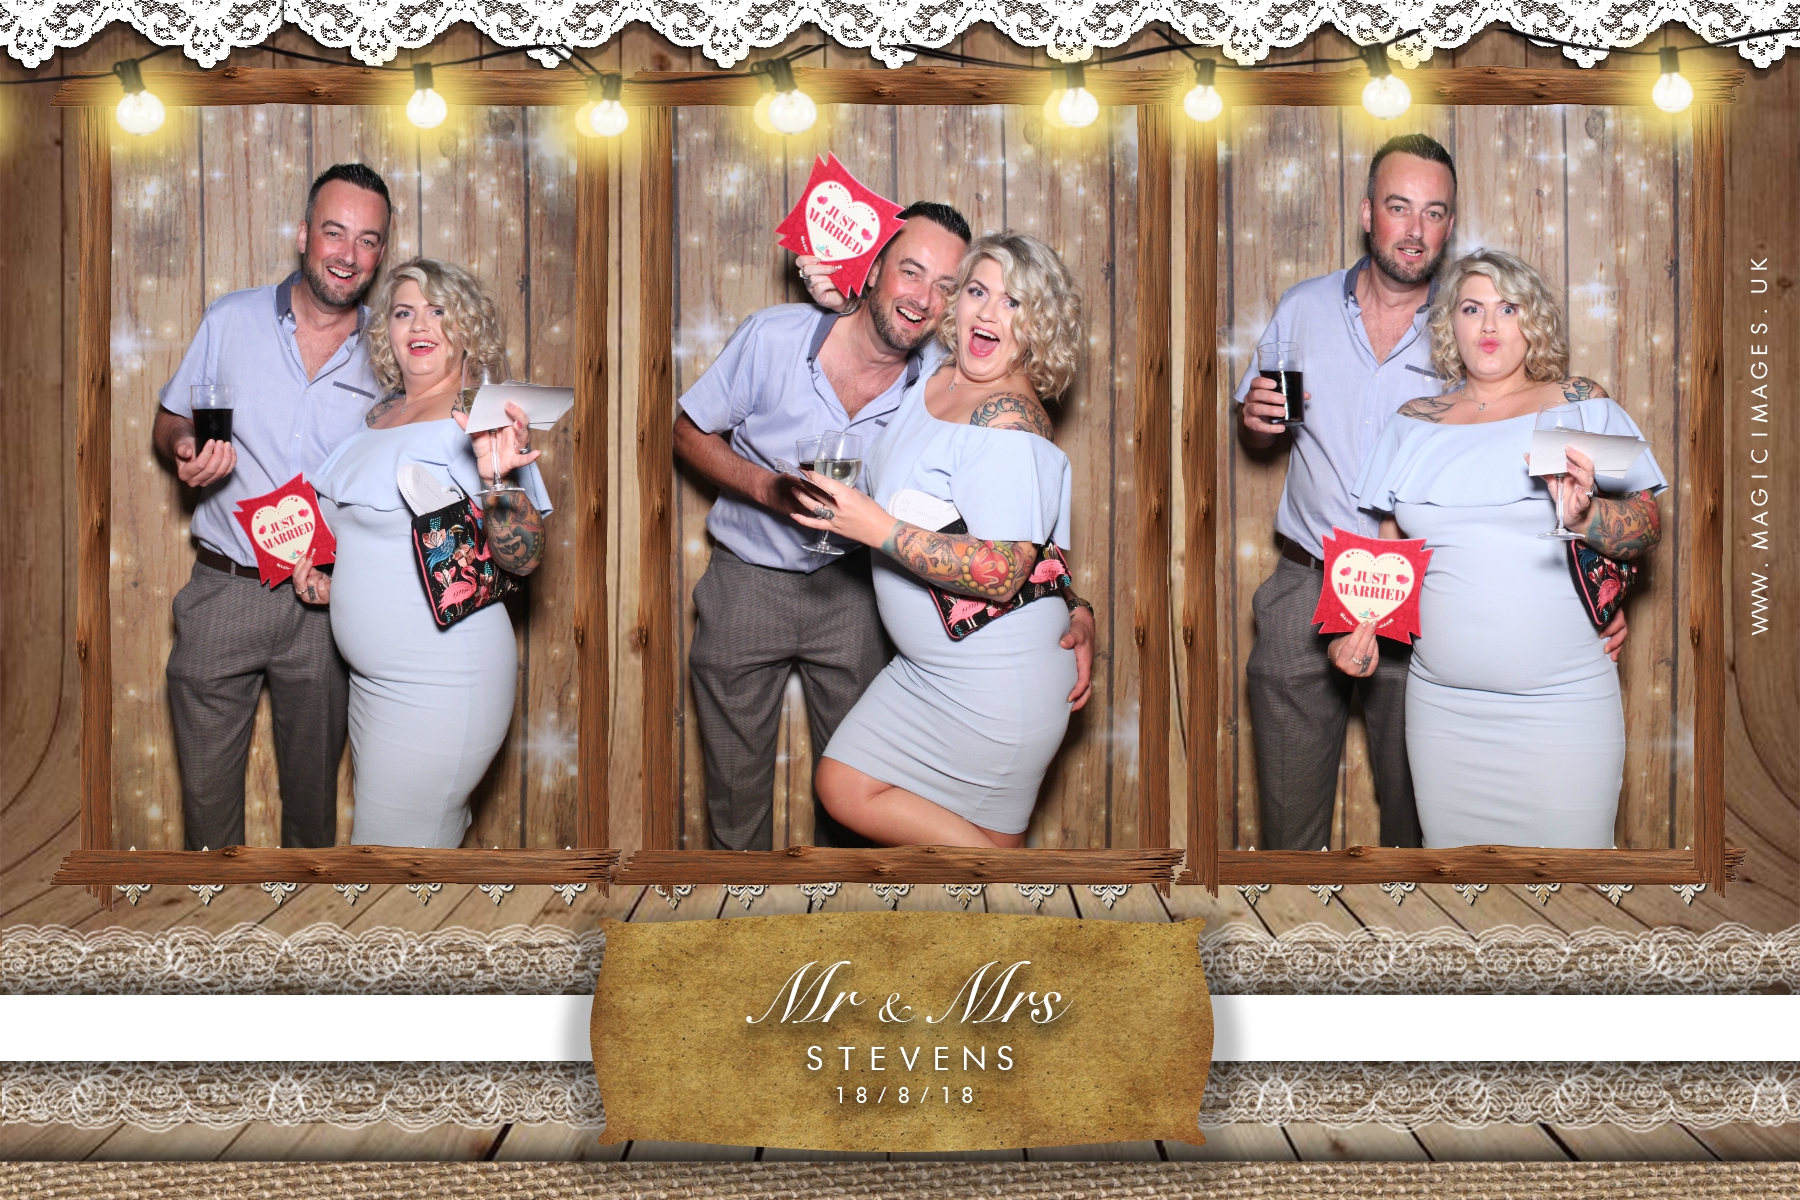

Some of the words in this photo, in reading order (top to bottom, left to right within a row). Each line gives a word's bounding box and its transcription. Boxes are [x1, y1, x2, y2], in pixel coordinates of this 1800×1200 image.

[825, 205, 859, 232] JUST
[806, 207, 864, 255] MARRIED
[262, 521, 314, 550] MARRIED
[270, 514, 296, 535] JUST
[1353, 570, 1391, 585] JUST
[1336, 582, 1406, 602] MARRIED
